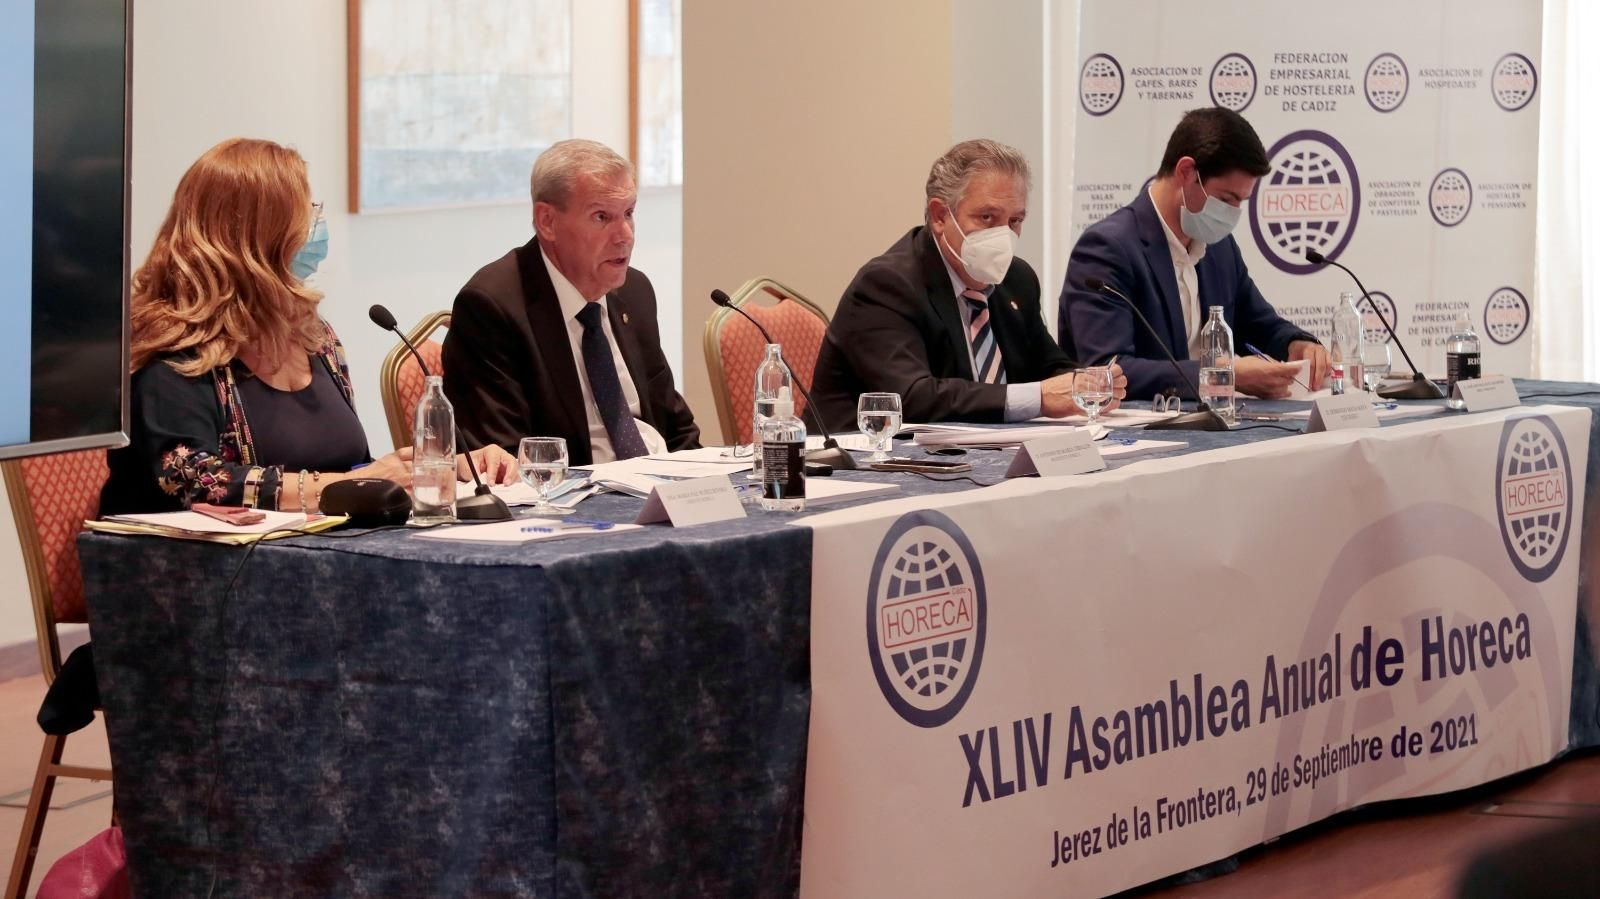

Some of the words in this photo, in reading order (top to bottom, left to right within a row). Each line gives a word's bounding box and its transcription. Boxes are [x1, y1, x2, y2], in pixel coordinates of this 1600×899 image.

[1274, 53, 1348, 64] FEDERACION
[1131, 67, 1189, 76] ASOCIACION
[1191, 67, 1203, 76] DE
[1269, 69, 1351, 80] EMPRESARIAL
[1418, 69, 1470, 78] ASOCIACION
[1472, 68, 1483, 77] DE
[1168, 79, 1198, 88] BARES
[1424, 80, 1477, 89] HOSPEDAJES
[1138, 92, 1144, 100] Y
[1145, 91, 1194, 100] TABERNAS
[1264, 85, 1280, 96] DE
[1283, 85, 1355, 96] HOSTELERIA
[1282, 101, 1297, 112] DE
[1299, 101, 1337, 112] CADIZ
[1368, 181, 1411, 189] ASOCIACION
[1265, 193, 1345, 212] HORECA
[1278, 306, 1322, 315] OCIACION
[1415, 302, 1470, 311] FEDERACION
[1408, 327, 1419, 336] DE
[1420, 338, 1431, 347] DE
[1508, 479, 1564, 509] HORECA
[886, 597, 970, 639] HORECA
[958, 712, 1052, 808] XLIV
[1064, 673, 1250, 780] Asamblea
[1259, 632, 1342, 725] Anual
[1350, 625, 1405, 692] de
[1420, 612, 1532, 682] Horeca
[1051, 826, 1102, 868] Jerez
[1106, 812, 1129, 850] de
[1133, 806, 1152, 841] la
[1156, 785, 1242, 834] Frontera,
[1245, 767, 1268, 807] 29
[1271, 762, 1290, 797] de
[1293, 733, 1383, 790] Septiembre
[1390, 725, 1423, 758] de
[1429, 712, 1479, 755] 2021
